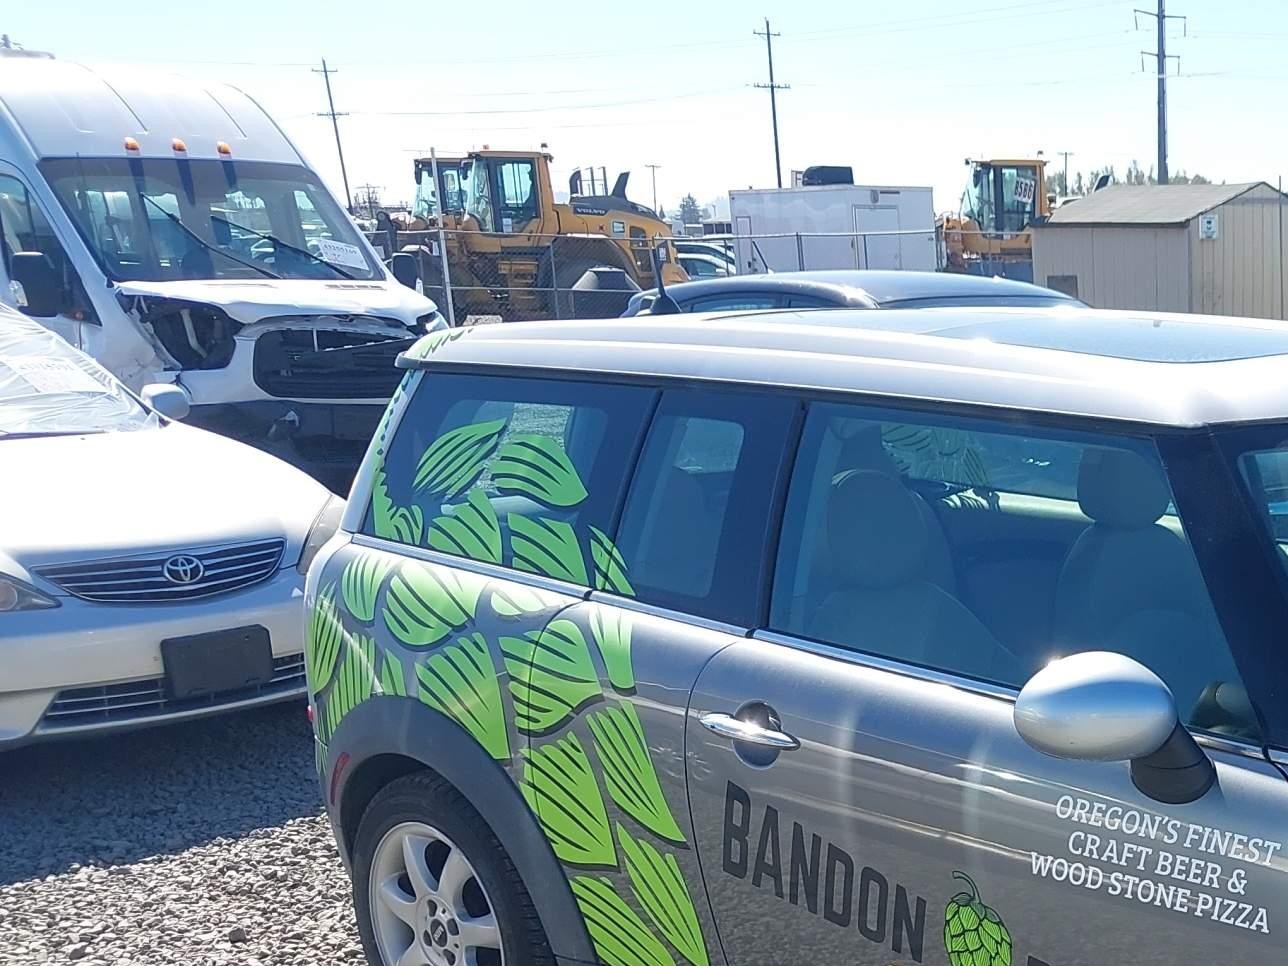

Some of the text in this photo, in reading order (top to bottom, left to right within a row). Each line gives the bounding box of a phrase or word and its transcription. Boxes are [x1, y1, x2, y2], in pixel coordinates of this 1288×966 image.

[1056, 795, 1281, 866] OREGON'S FINEST
[1068, 831, 1248, 895] CRAFT BEER &
[722, 780, 927, 963] BANDON
[1031, 852, 1270, 934] WOOD STONE PIZZA
